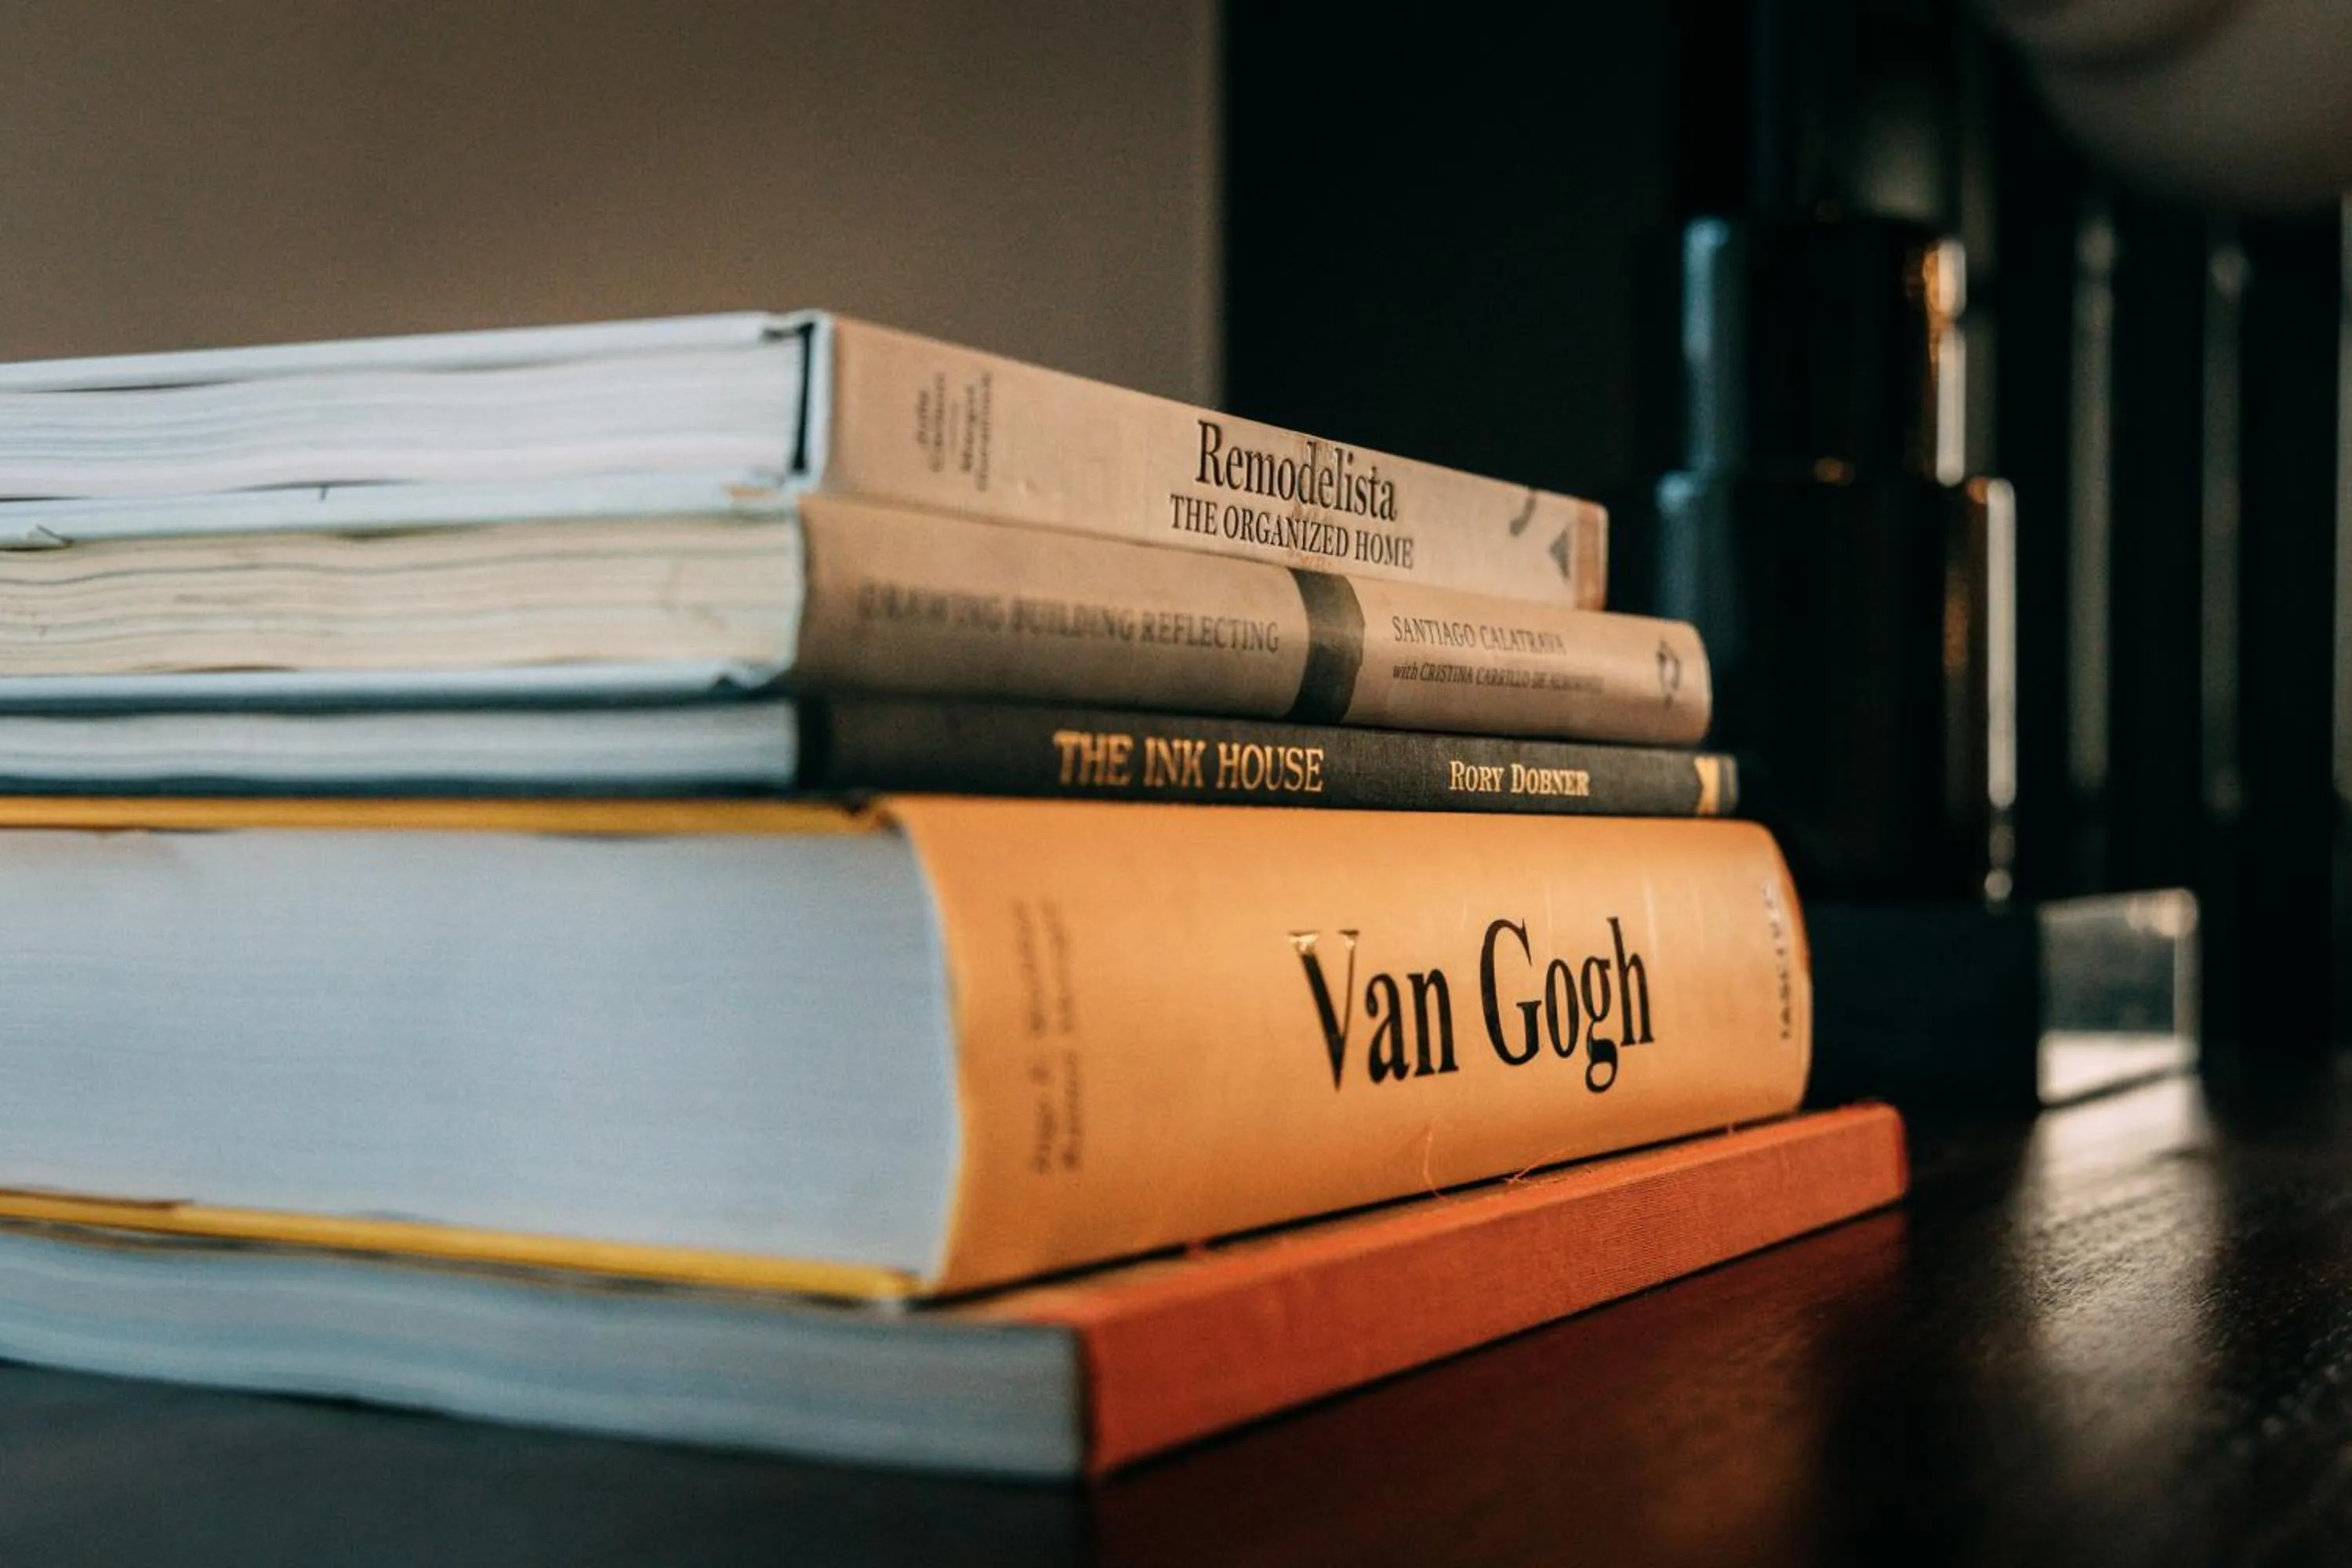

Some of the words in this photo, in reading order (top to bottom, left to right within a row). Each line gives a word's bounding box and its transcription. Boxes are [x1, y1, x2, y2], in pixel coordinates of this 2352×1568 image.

[1196, 419, 1397, 521] Remodelista
[1169, 493, 1218, 536] THE
[1223, 506, 1349, 557] ORGANIZED
[1354, 529, 1414, 569] HOME
[1139, 609, 1280, 653] REFLECTING
[1392, 615, 1476, 648] SANTIAGO
[1479, 625, 1567, 656] CALATRAVA
[1392, 662, 1417, 681] with
[1419, 662, 1473, 684] CRISTINA
[1053, 729, 1134, 786] THE
[1143, 735, 1206, 788] INK
[1216, 742, 1324, 793] HOUSE
[1449, 760, 1505, 792] RORY
[1510, 764, 1590, 796] DOBNER
[1287, 929, 1459, 1091] Van
[1479, 916, 1655, 1094] Gogh
